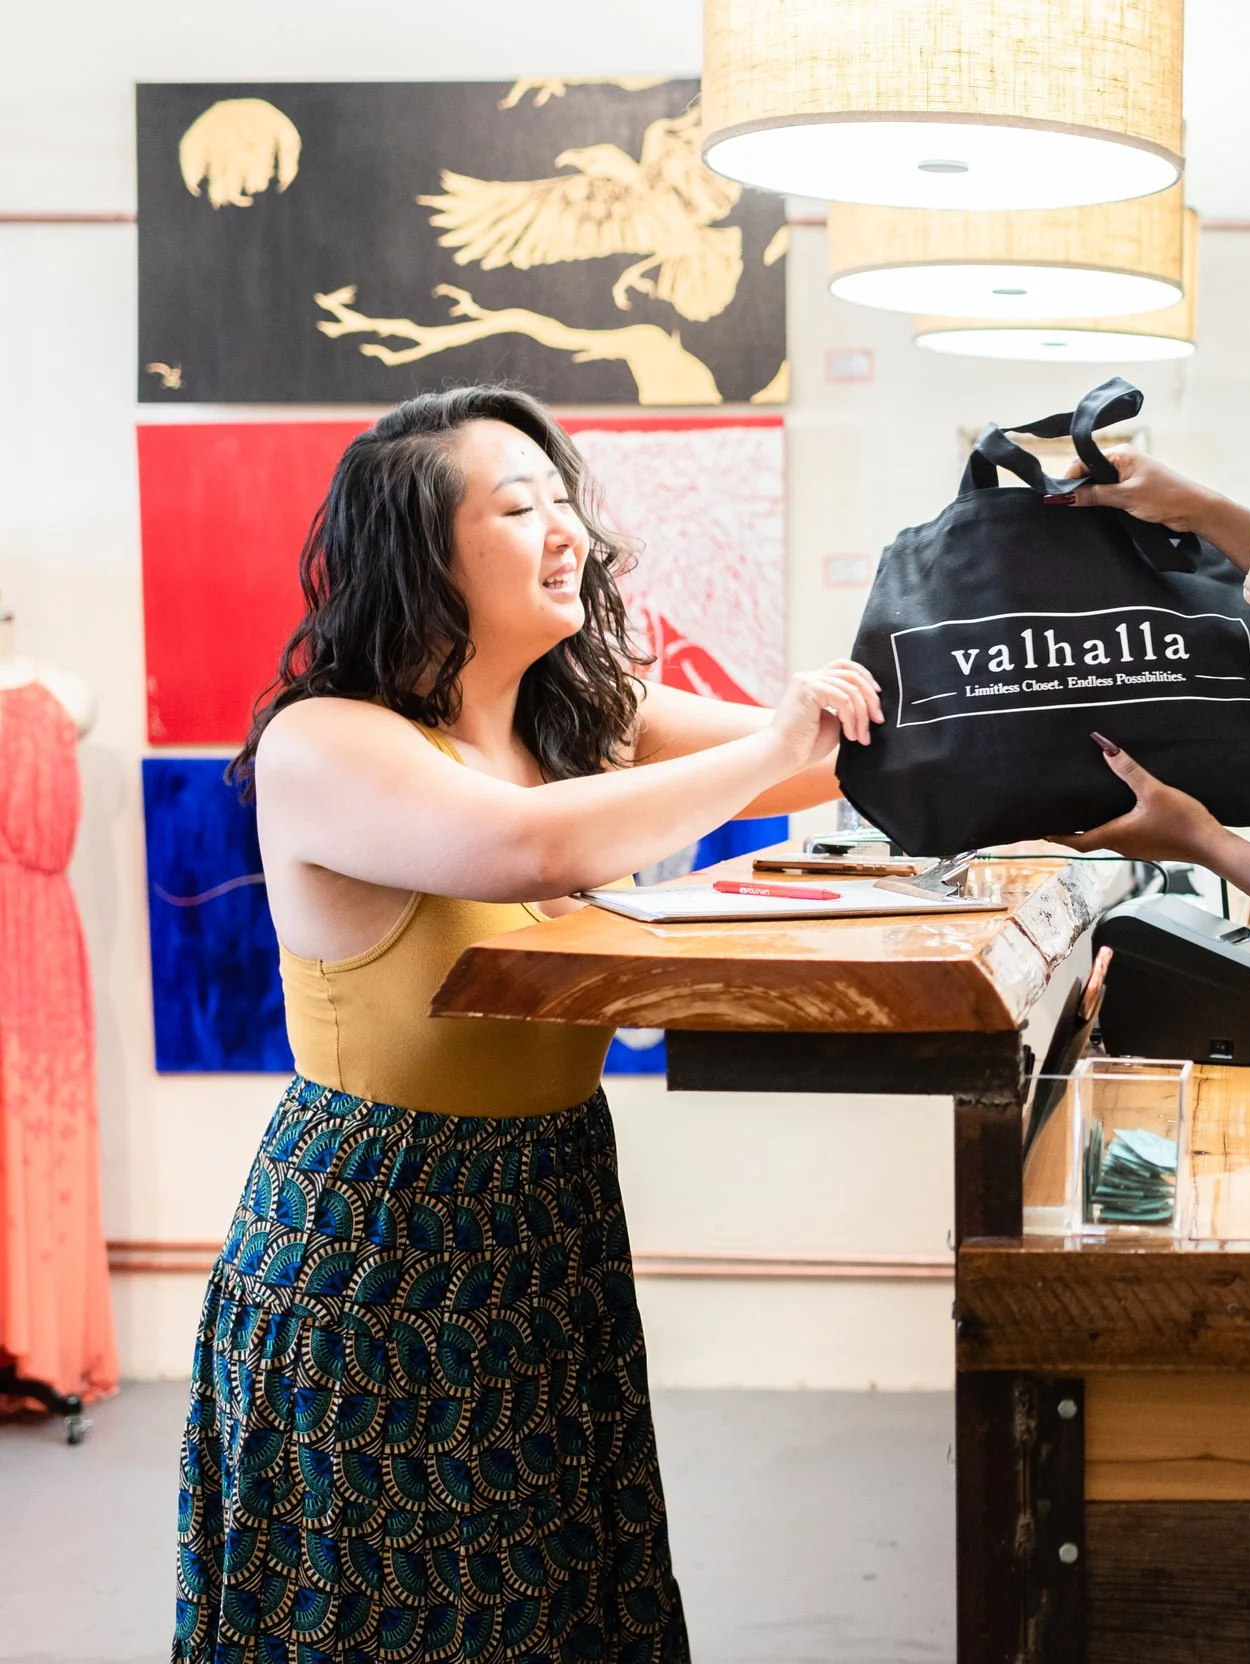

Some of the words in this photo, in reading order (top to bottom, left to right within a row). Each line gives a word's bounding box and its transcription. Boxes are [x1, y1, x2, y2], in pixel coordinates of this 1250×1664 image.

[950, 621, 1190, 676] valhalla
[965, 683, 1020, 697] Limitless
[1021, 679, 1063, 692] Closet.
[1067, 676, 1114, 688] Endless
[1116, 671, 1187, 684] Possibilities.
